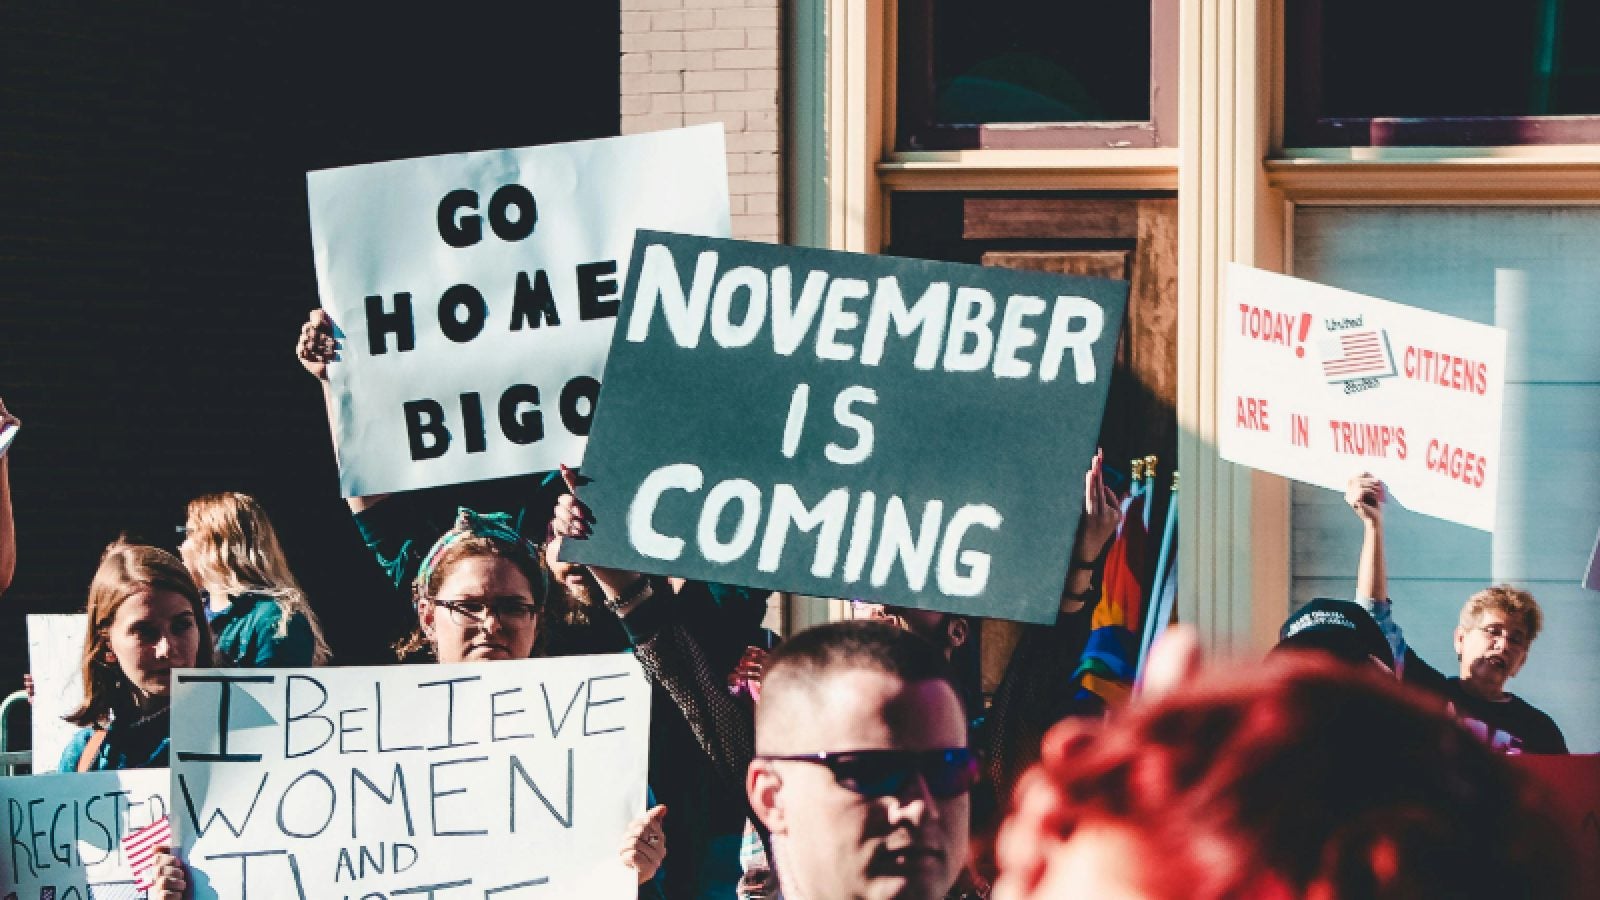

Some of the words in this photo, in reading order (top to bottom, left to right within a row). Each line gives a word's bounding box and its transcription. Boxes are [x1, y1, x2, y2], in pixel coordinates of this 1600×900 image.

[436, 183, 539, 248] GO
[364, 259, 621, 356] HOME
[626, 243, 1105, 385] NOVEMBER
[1239, 303, 1312, 358] TODAY!
[1404, 345, 1487, 396] CITIZENS
[403, 375, 602, 462] BIGO
[781, 383, 879, 466] IS
[1236, 396, 1270, 432] ARE
[1291, 413, 1309, 448] IN
[1329, 419, 1408, 460] TRUMP'S
[1425, 438, 1487, 488] CAGES
[627, 463, 1004, 598] COMING
[177, 675, 275, 763] I
[178, 747, 574, 840] WOMEN
[335, 841, 419, 882] AND
